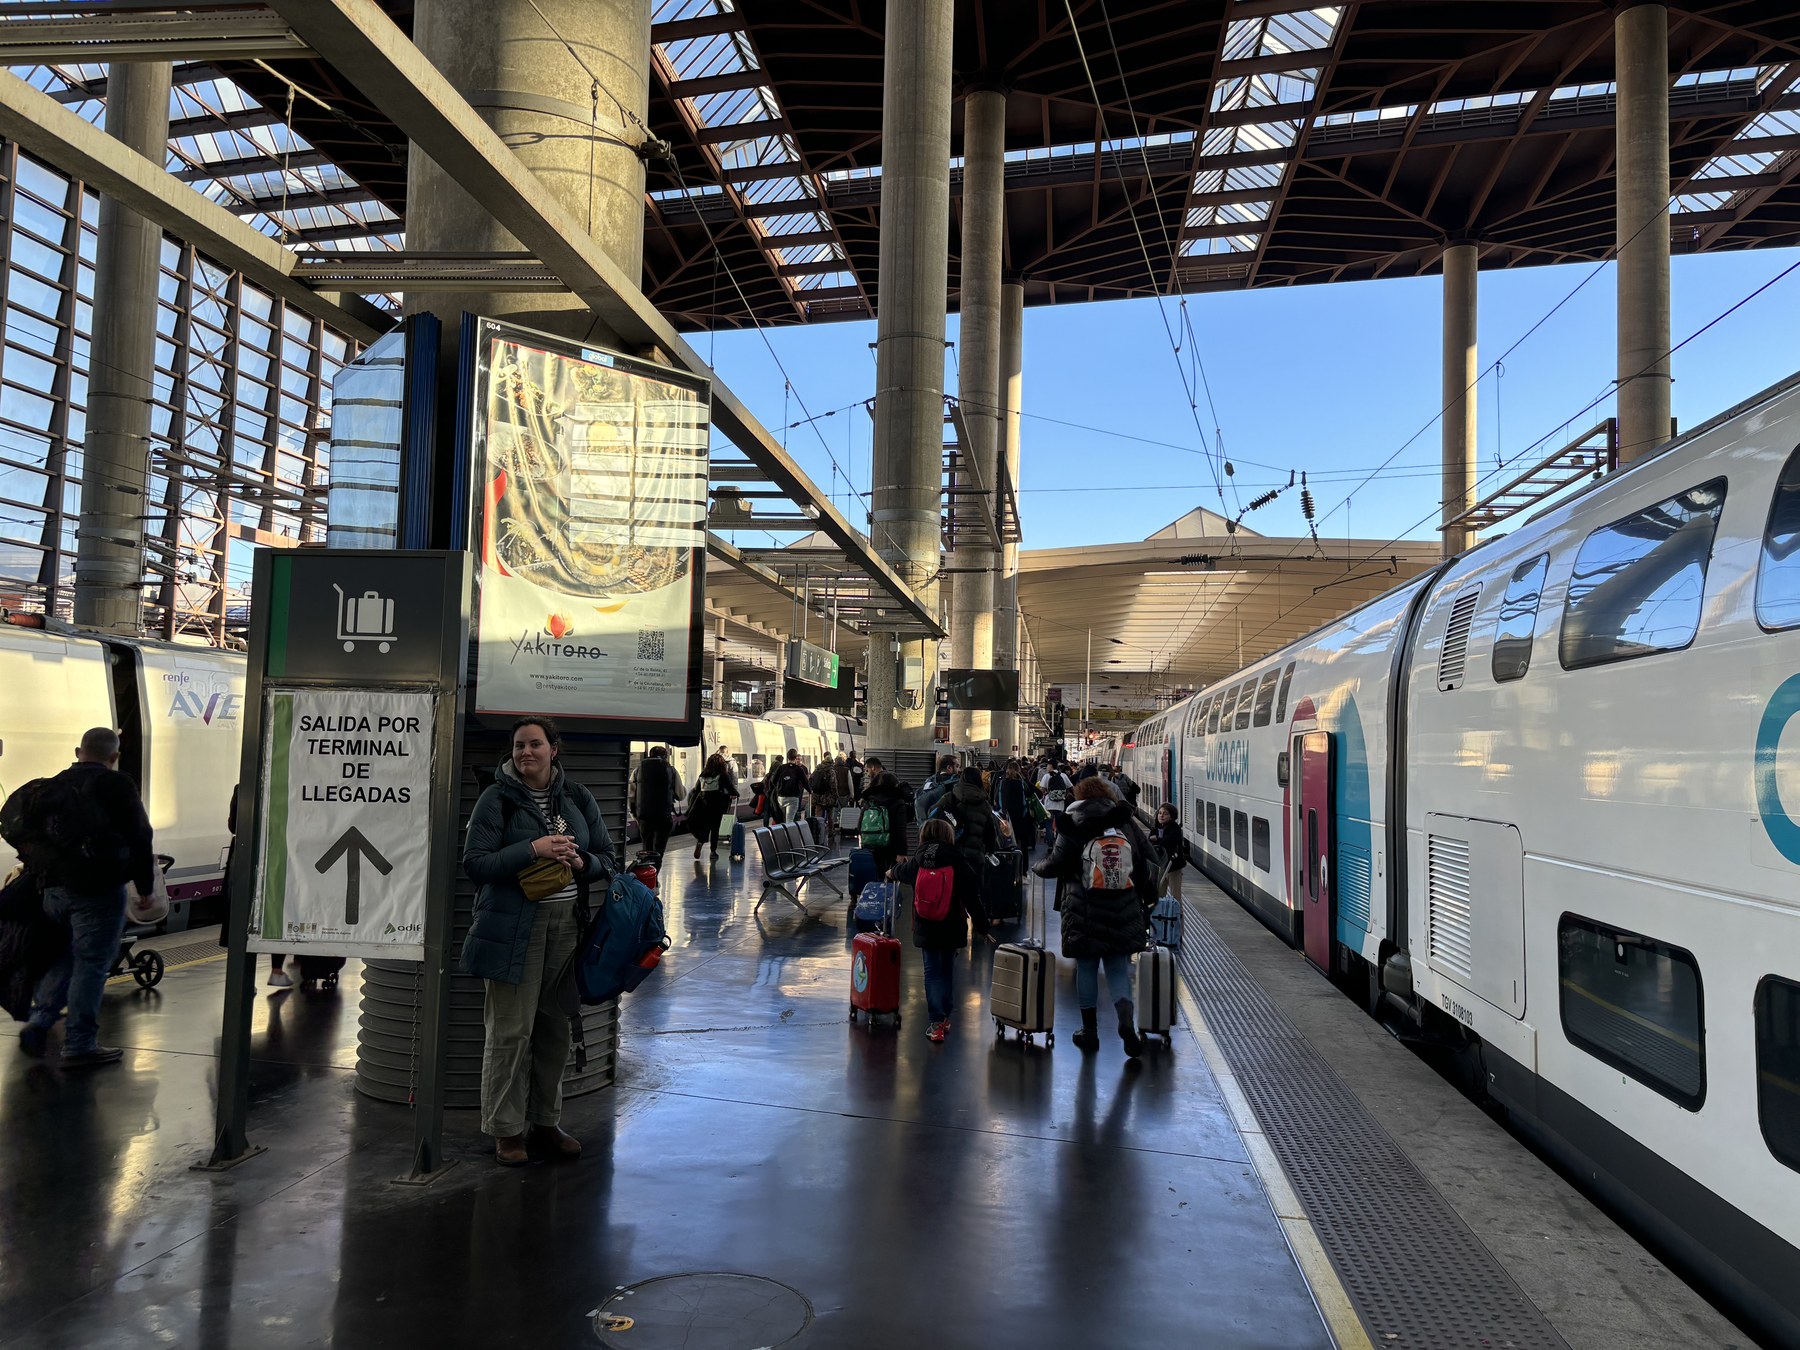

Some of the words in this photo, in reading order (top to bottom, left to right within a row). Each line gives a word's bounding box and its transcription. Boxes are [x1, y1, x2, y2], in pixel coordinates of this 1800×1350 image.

[486, 321, 501, 332] 604
[588, 352, 608, 363] global
[163, 671, 190, 686] renfe
[529, 674, 584, 682] www.yakitoro.com
[168, 690, 244, 726] AVE
[300, 715, 371, 733] SALIDA
[378, 716, 420, 733] POR
[308, 739, 409, 757] TERMINAL
[342, 762, 370, 779] DE
[1206, 739, 1249, 786] OUIGO.COM
[302, 785, 411, 803] LLEGADAS
[397, 923, 424, 932] adif
[1441, 993, 1453, 1011] TGV
